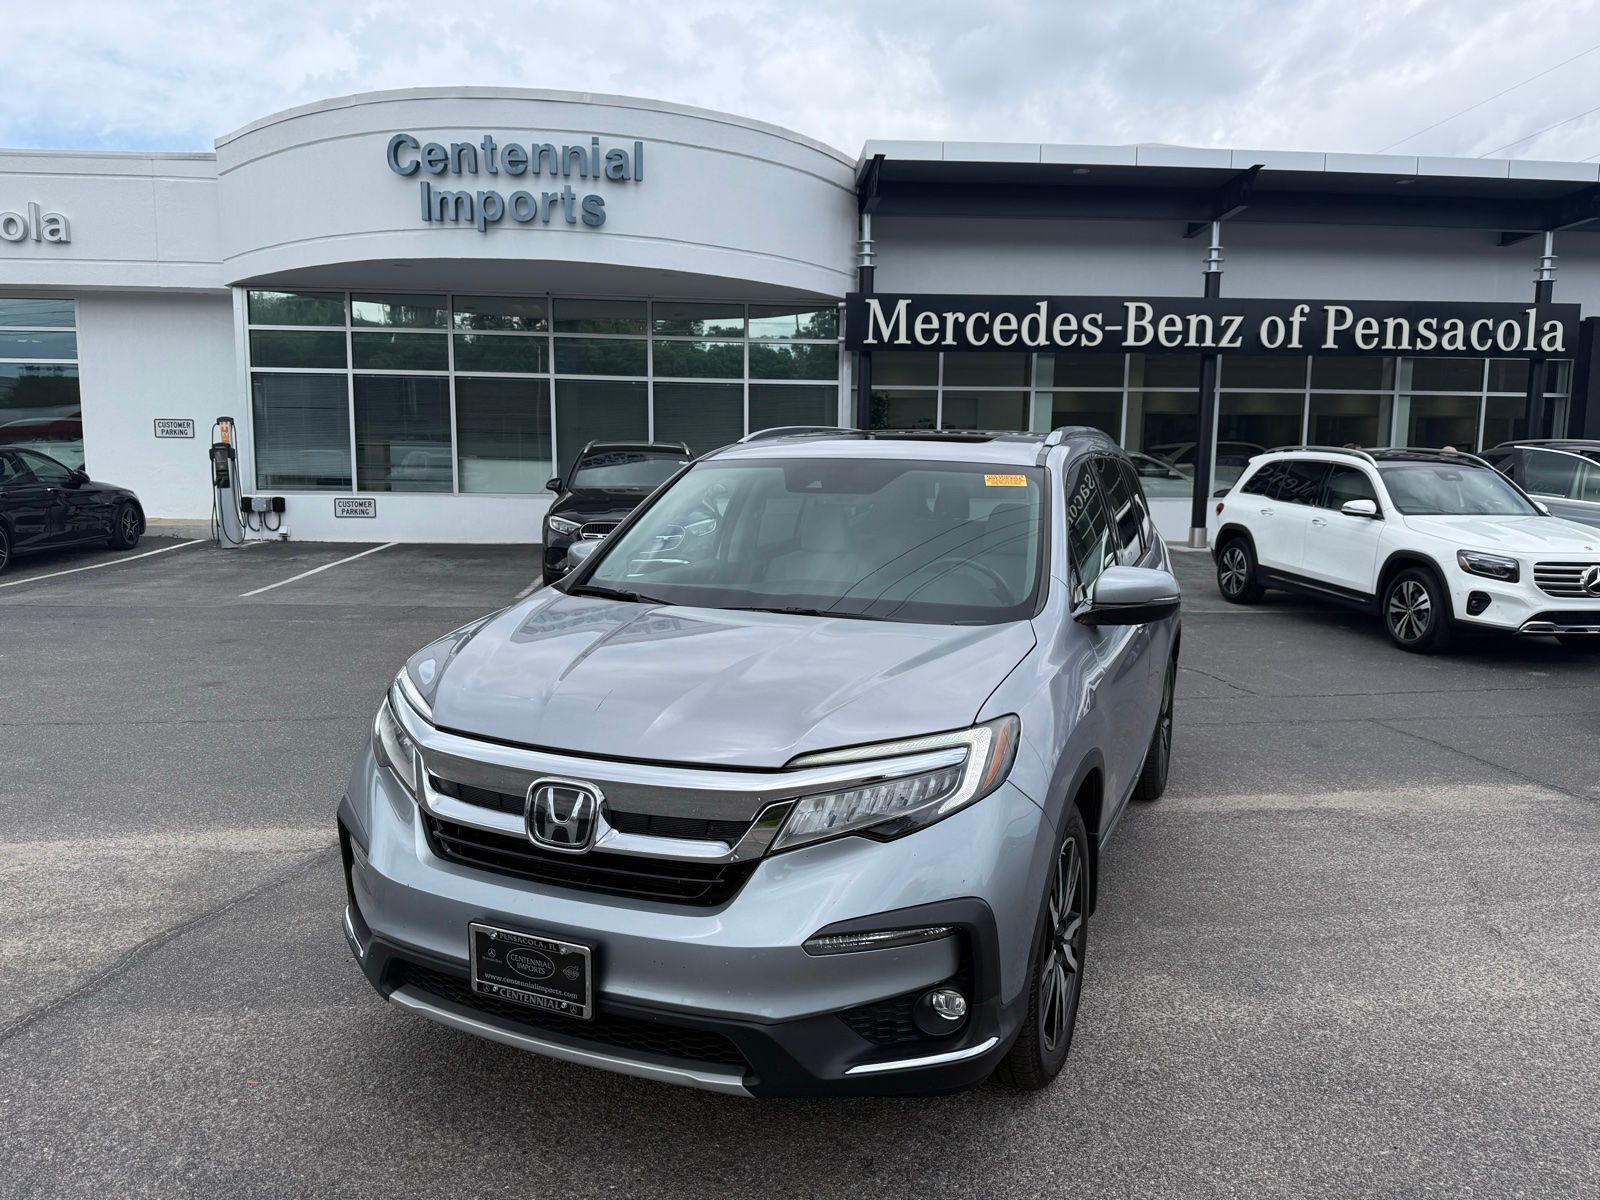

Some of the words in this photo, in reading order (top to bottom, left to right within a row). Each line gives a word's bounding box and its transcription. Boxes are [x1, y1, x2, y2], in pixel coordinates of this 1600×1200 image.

[386, 133, 644, 182] Centennial
[420, 181, 607, 232] Imports
[863, 299, 1243, 348] Mercedes-Benz
[1259, 304, 1310, 349] of
[1321, 305, 1566, 352] Pensacola
[157, 421, 191, 429] CUSTOMER
[338, 500, 373, 508] CUSTOMER
[341, 508, 370, 516] PARKING
[549, 943, 557, 951] FL
[510, 953, 552, 969] CENTENNIAL
[516, 961, 546, 975] IMPORTS
[484, 973, 578, 999] www.centennialimports.com
[499, 988, 561, 1010] CENTENNIAL
